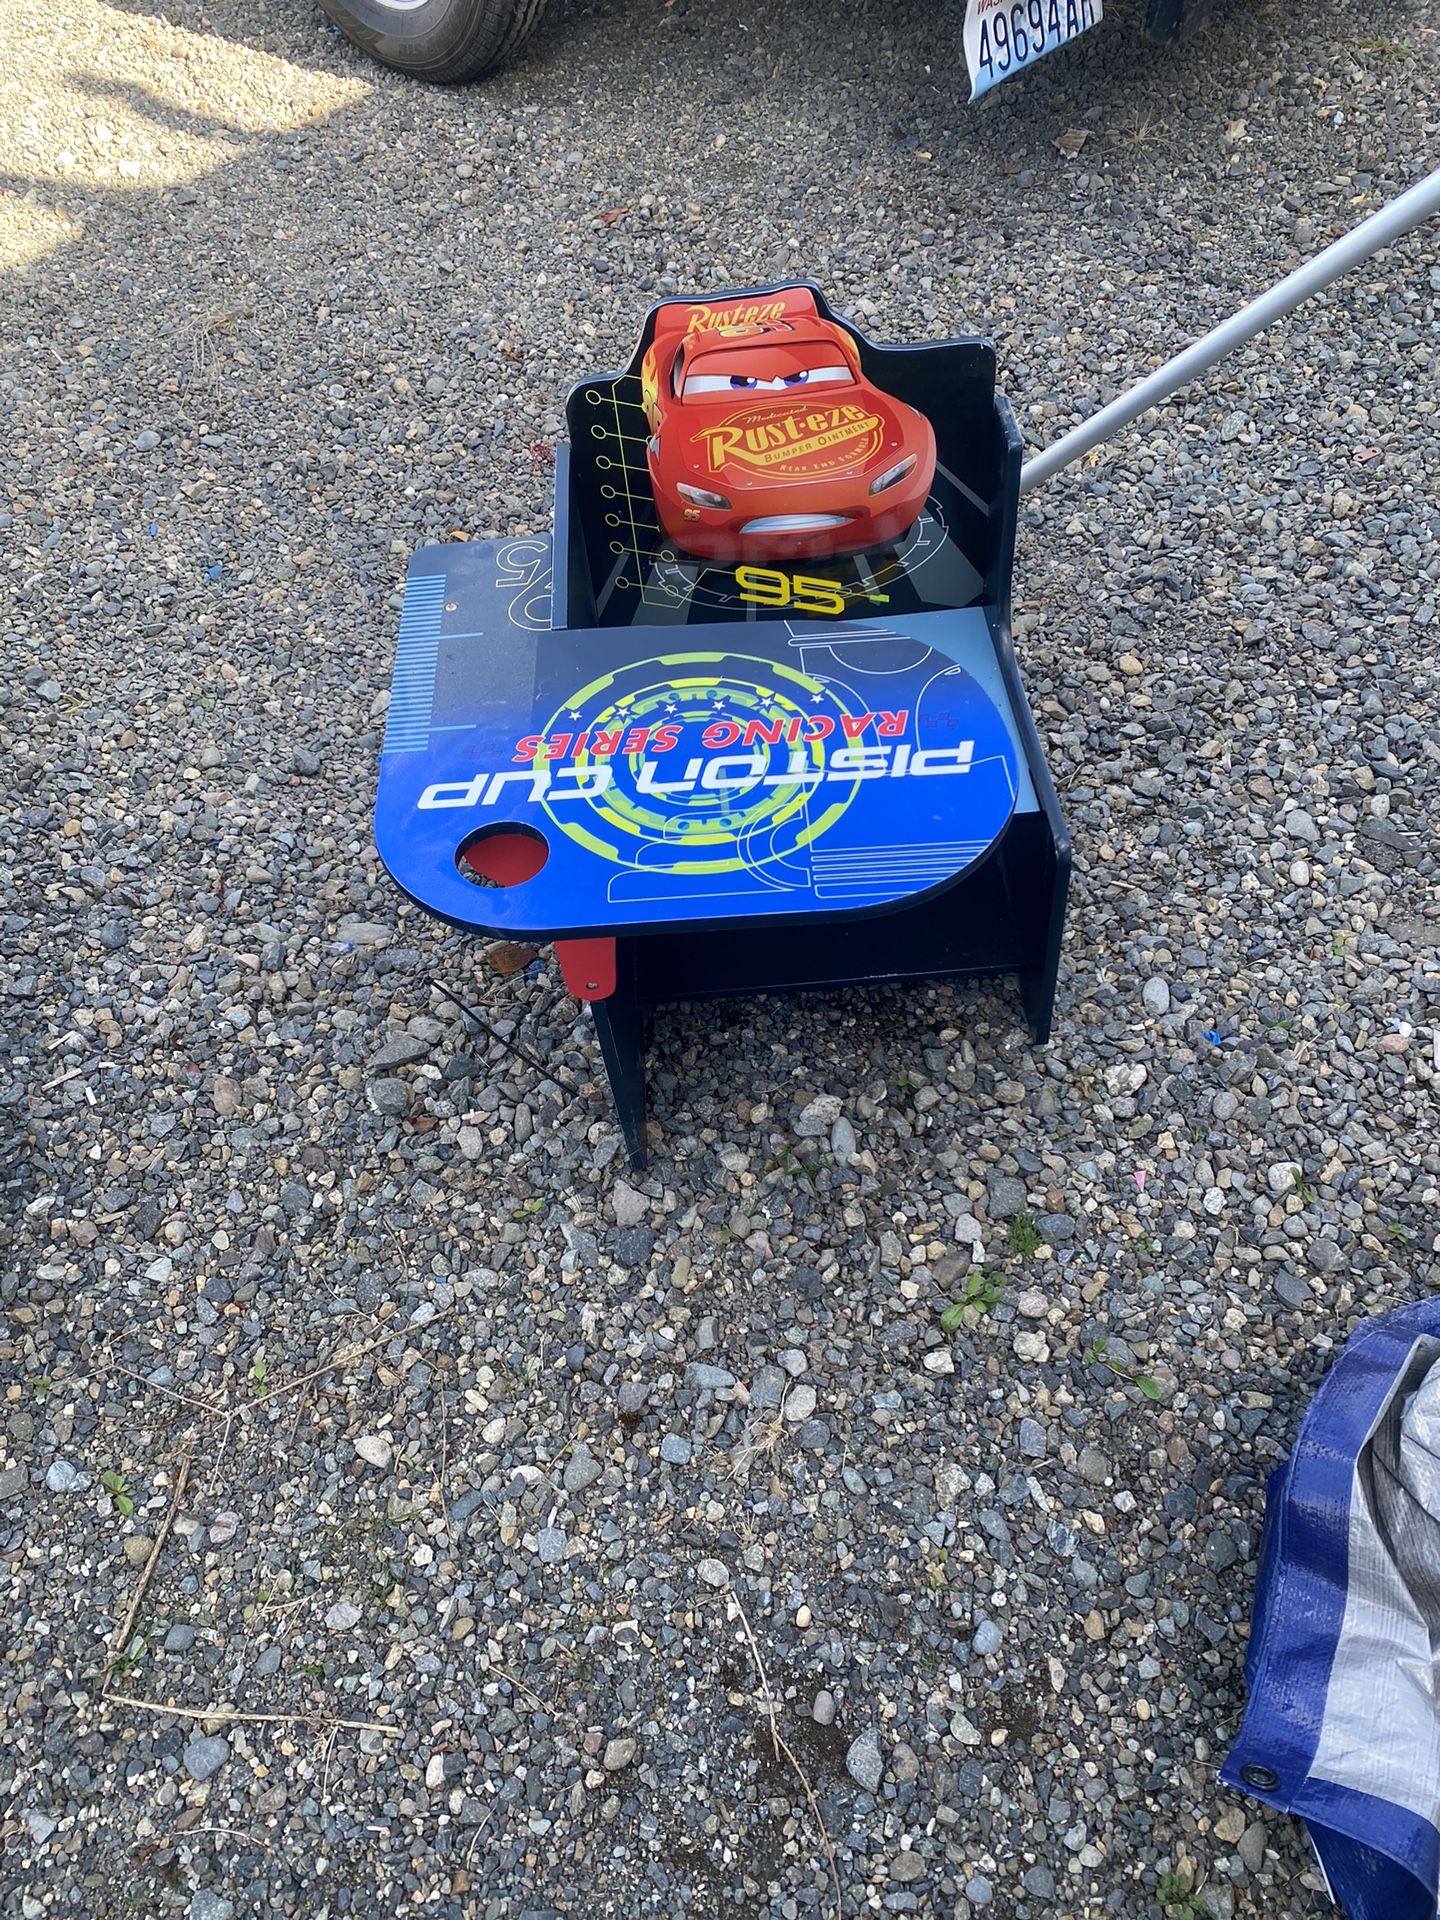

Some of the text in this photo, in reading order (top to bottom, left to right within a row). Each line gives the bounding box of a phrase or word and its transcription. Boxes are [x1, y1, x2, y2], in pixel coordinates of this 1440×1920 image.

[683, 508, 701, 521] 95
[736, 565, 845, 614] 95
[510, 709, 910, 763] RACING SERIES
[417, 739, 974, 810] PISTON CUP
